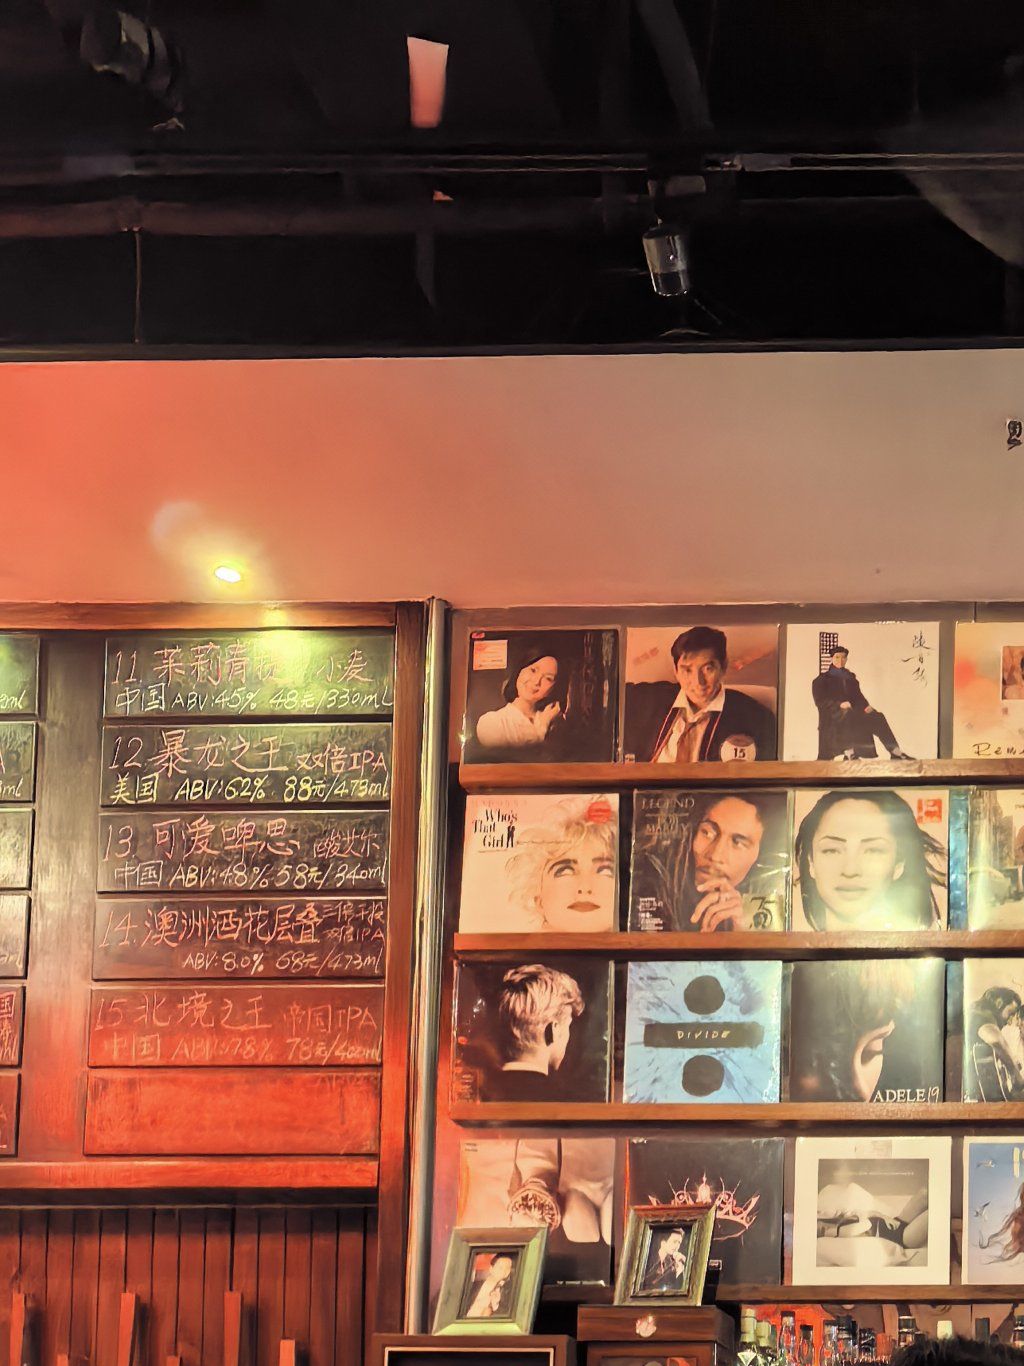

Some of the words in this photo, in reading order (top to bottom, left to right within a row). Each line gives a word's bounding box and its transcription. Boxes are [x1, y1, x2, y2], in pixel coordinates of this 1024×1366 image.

[116, 683, 166, 716] 中国
[733, 747, 746, 758] 15
[110, 772, 160, 805] 美国
[114, 860, 164, 889] 中国
[676, 1030, 731, 1040] DIVIDE
[873, 1088, 926, 1103] ADELE
[927, 1086, 940, 1103] 19
